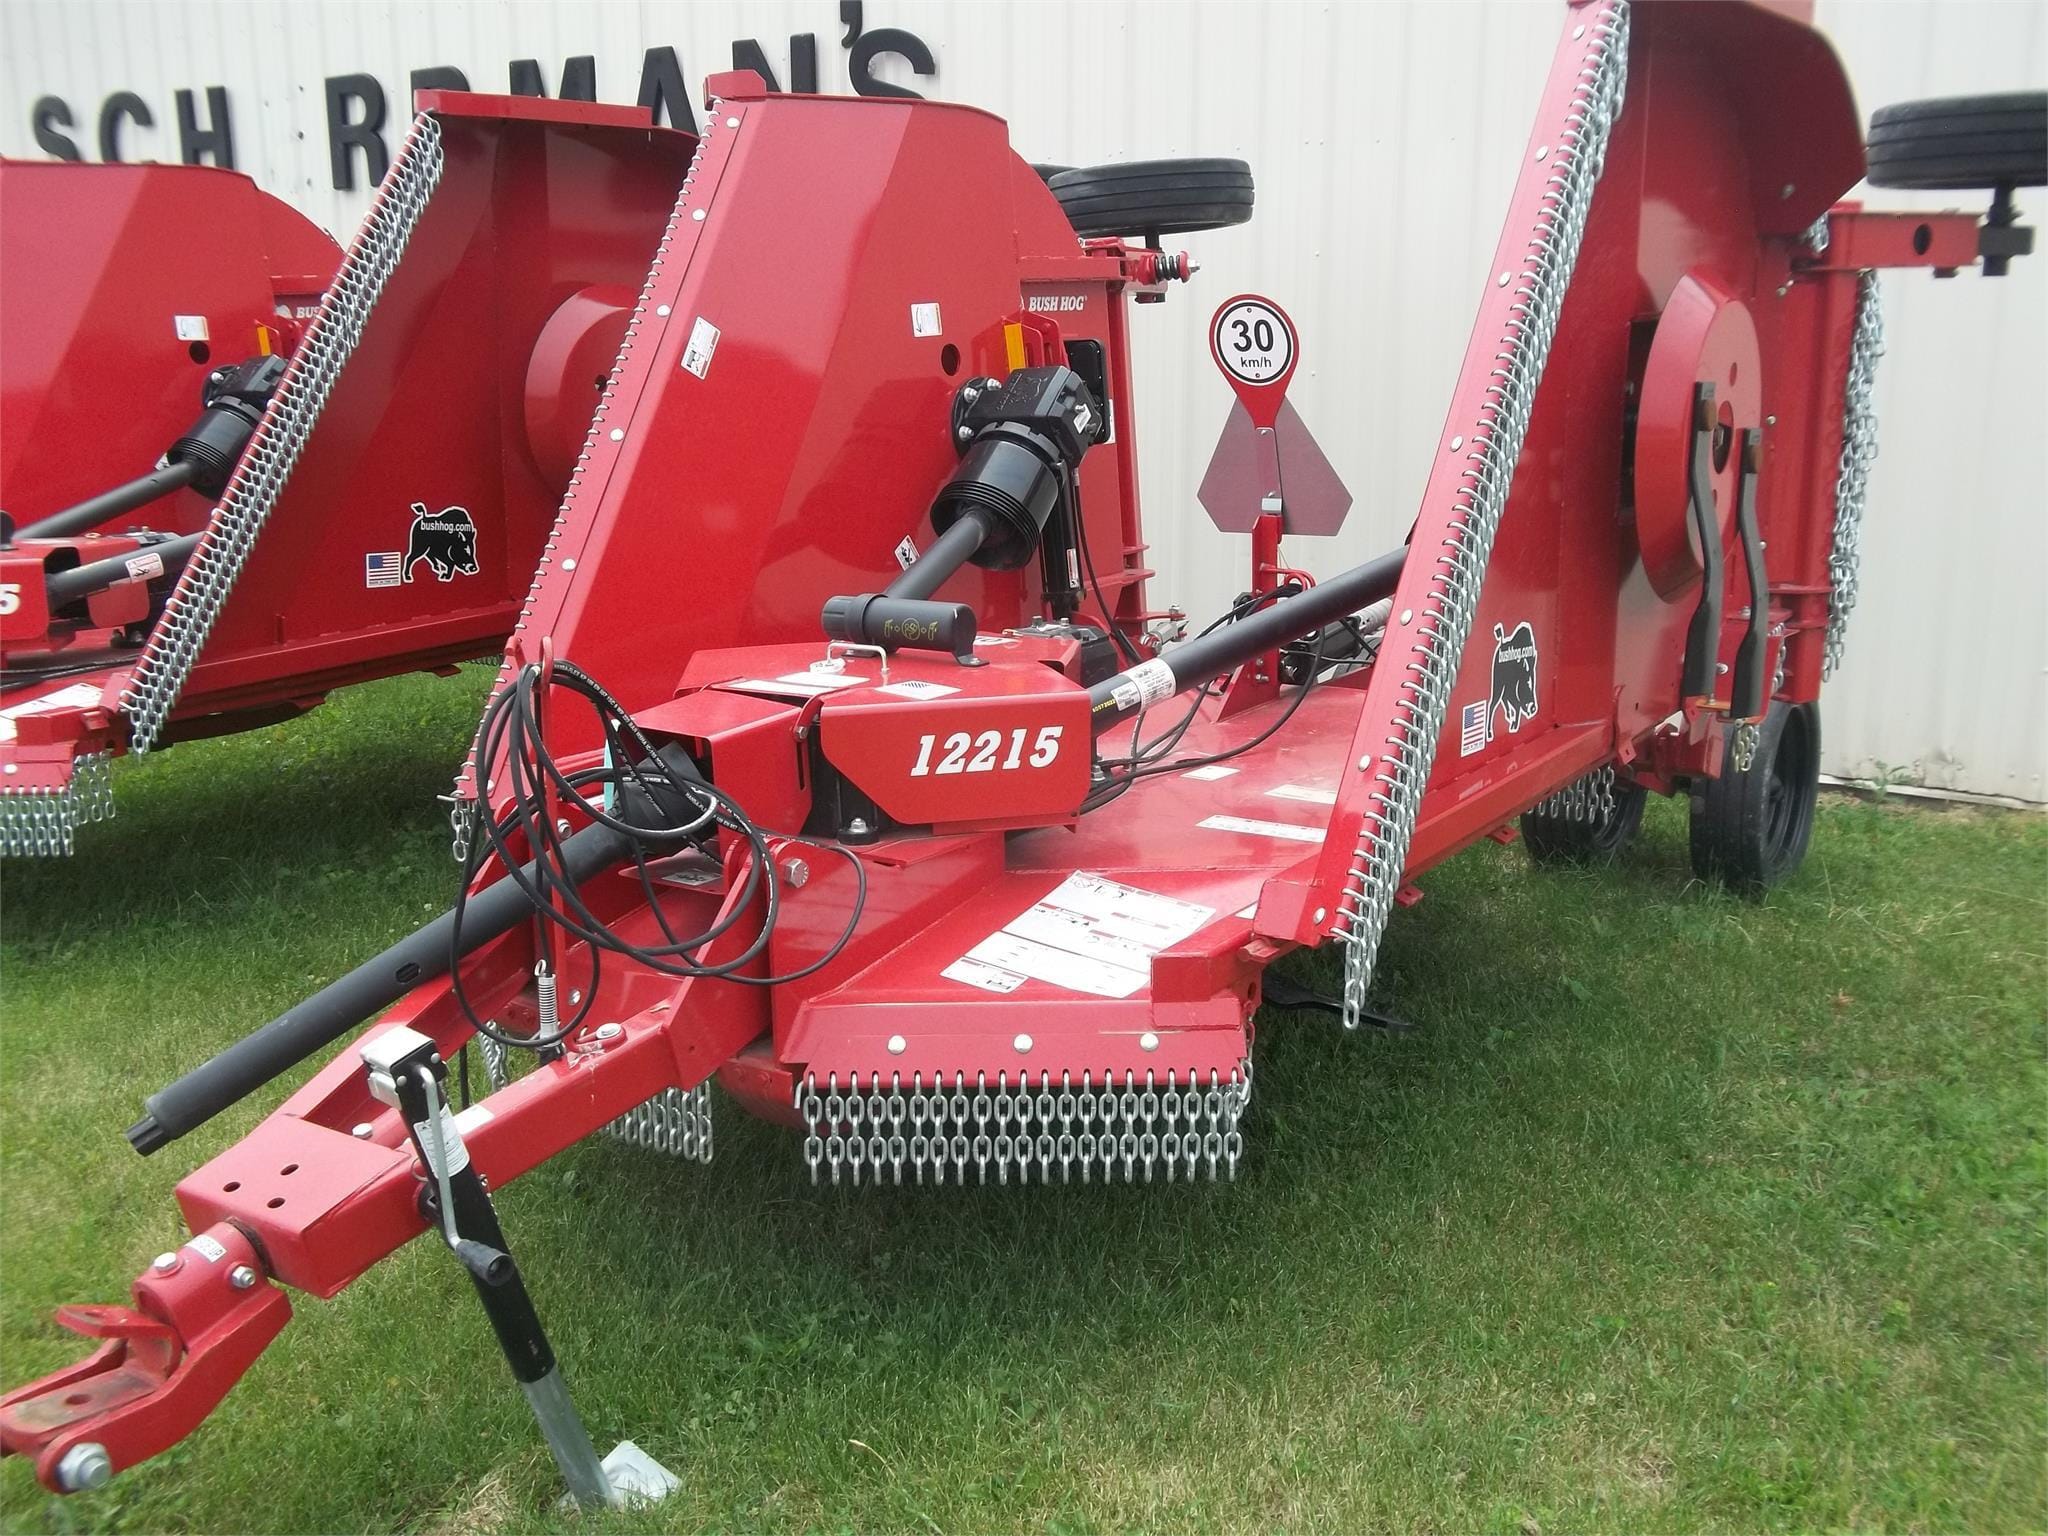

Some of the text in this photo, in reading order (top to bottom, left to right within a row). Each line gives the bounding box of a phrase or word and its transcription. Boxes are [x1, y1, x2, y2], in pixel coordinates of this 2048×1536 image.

[1029, 295, 1085, 312] BUSH HOG
[1231, 319, 1274, 352] 30
[1240, 356, 1272, 368] km/h
[420, 520, 471, 534] bushhog.com
[1498, 645, 1533, 663] bushhog.com
[910, 725, 1064, 777] 12215
